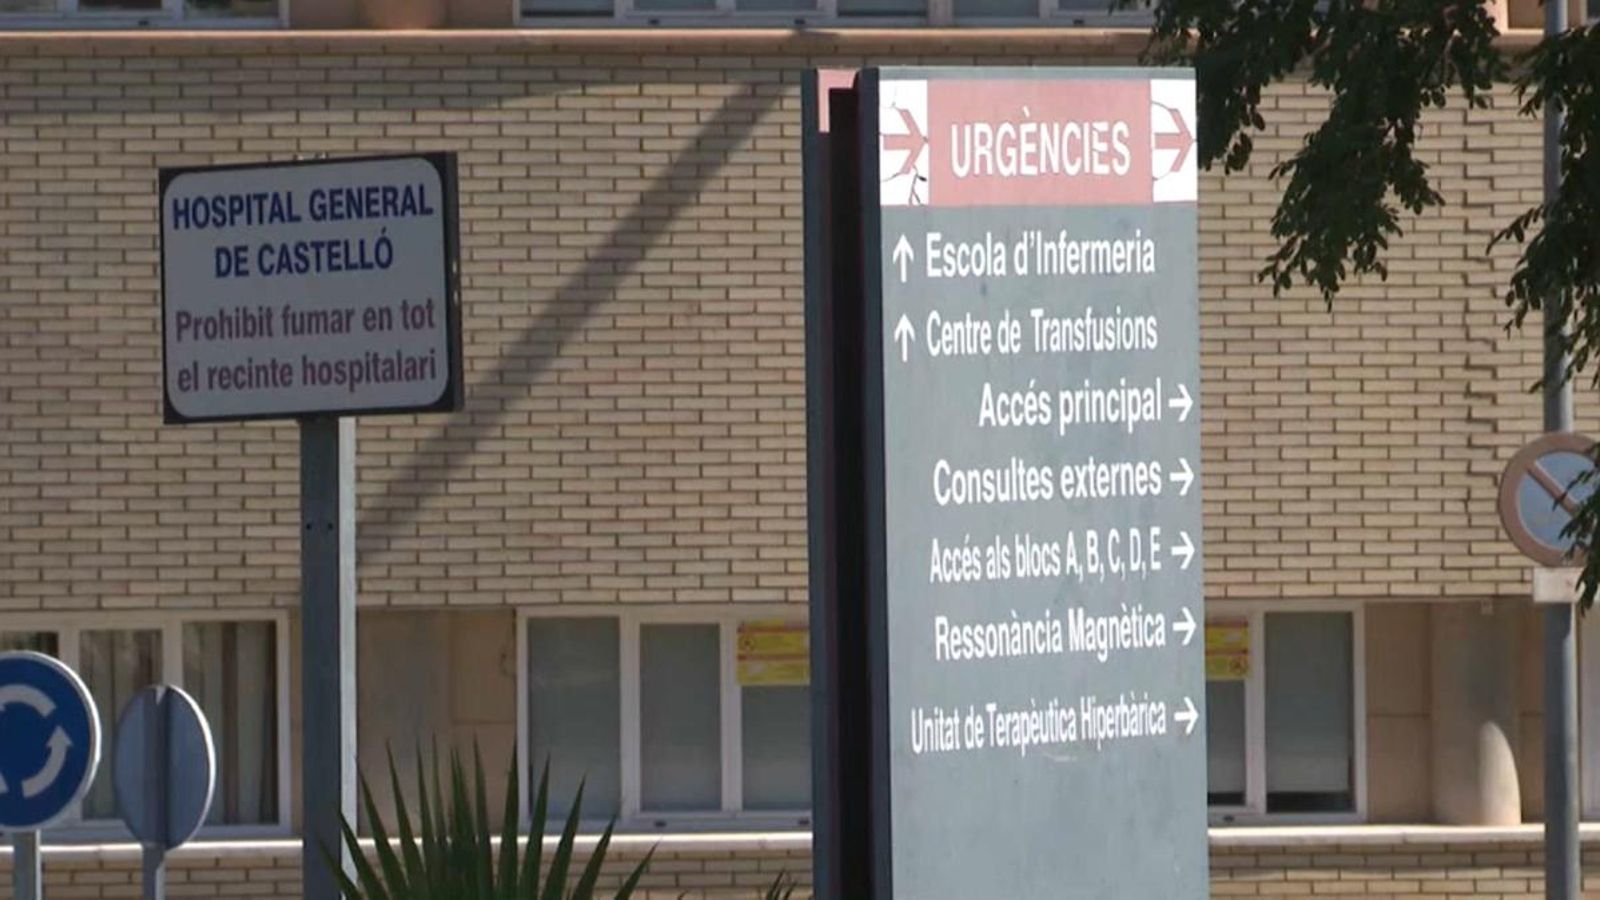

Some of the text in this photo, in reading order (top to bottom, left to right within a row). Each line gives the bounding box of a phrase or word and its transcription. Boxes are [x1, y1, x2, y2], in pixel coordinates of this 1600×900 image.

[951, 106, 1131, 178] URGÈNCIES
[172, 184, 434, 230] HOSPITAL GENERAL
[215, 227, 393, 278] DE CASTELLÓ
[926, 229, 1156, 278] Escola d'Infermeria
[175, 298, 435, 342] Prohibit fumar en tot
[926, 306, 1158, 357] Centre de Transfusions
[177, 349, 437, 393] el recinte hospitalari
[979, 377, 1162, 436] Accés principal
[933, 456, 1162, 506] Consultes externes
[929, 534, 981, 584] Accés
[986, 536, 1011, 580] als
[1015, 533, 1061, 578] blocs
[935, 603, 1166, 663] Ressonància Magnètica
[911, 691, 1167, 757] Unitat de Terapèutica Hiperbàrica
